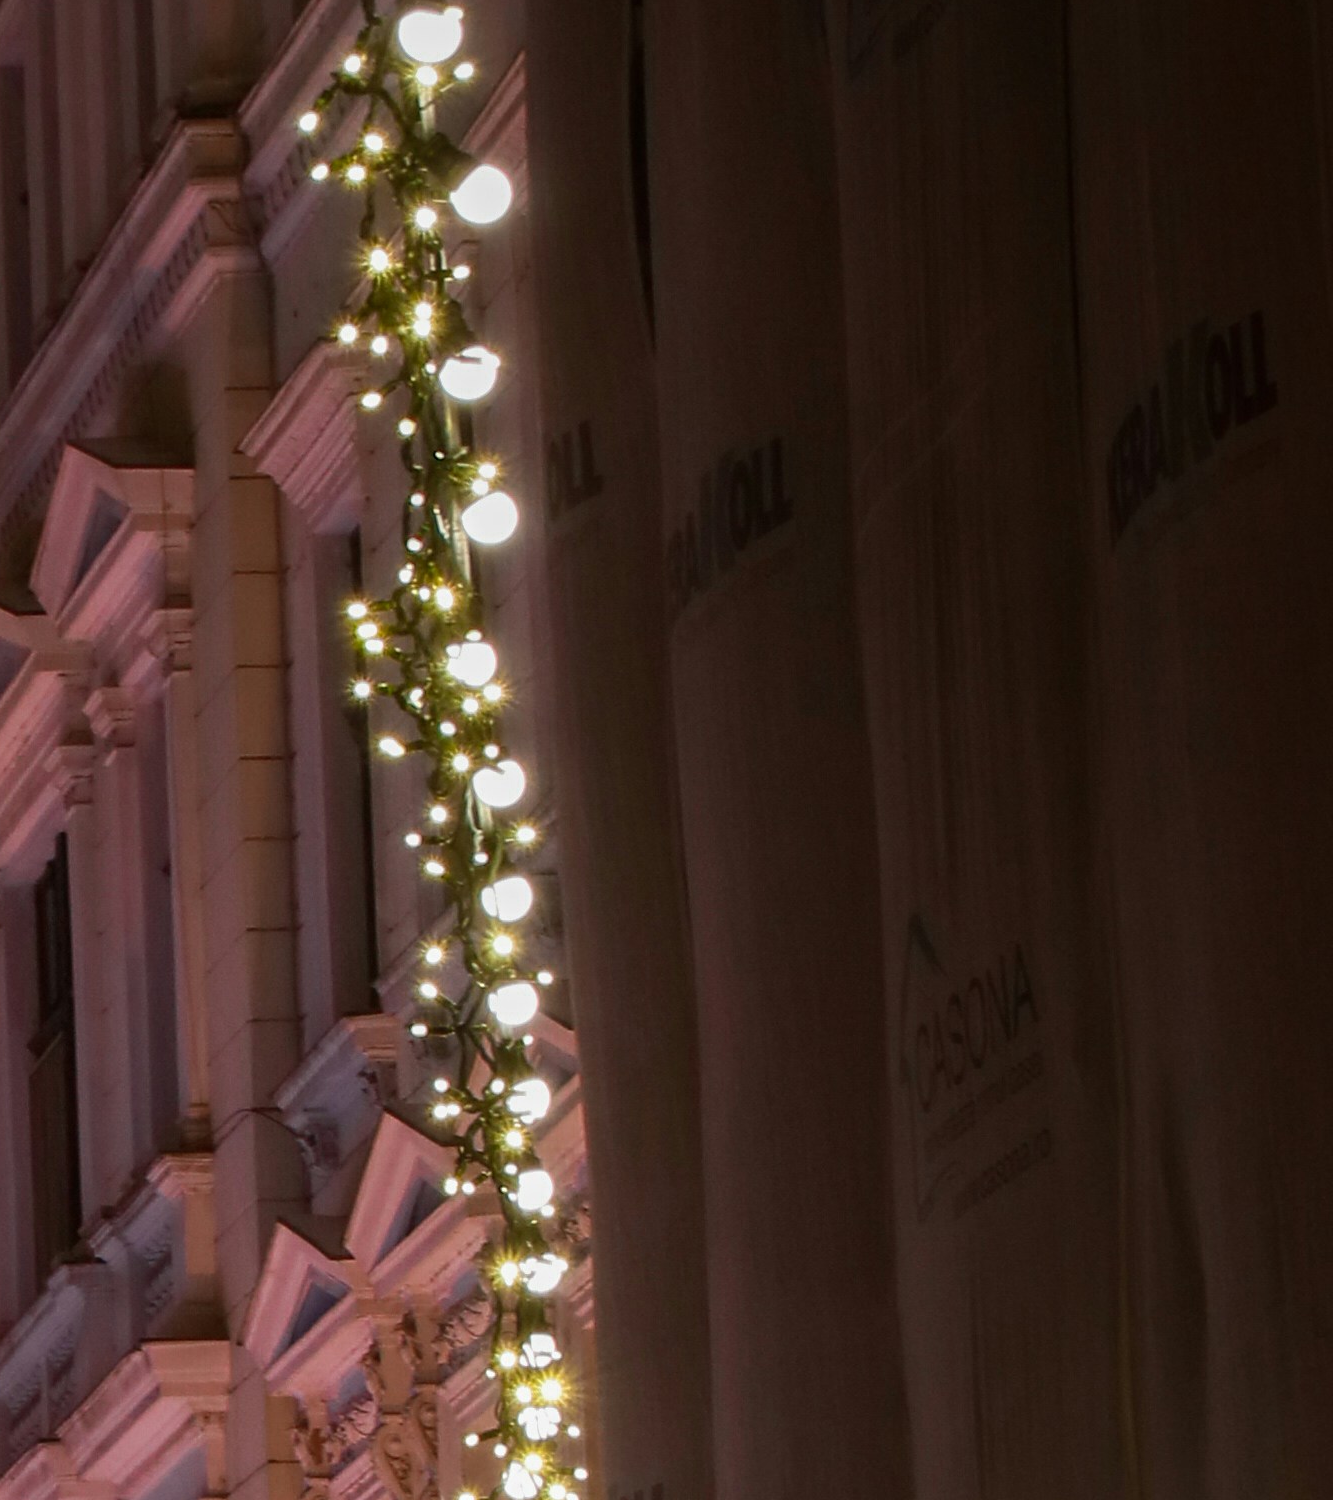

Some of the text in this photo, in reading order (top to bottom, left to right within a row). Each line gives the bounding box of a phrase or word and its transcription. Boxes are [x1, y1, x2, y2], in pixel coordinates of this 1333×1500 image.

[1107, 309, 1278, 553] KERAKOLL
[668, 436, 793, 608] RAKOLL
[916, 944, 1040, 1113] CASONA
